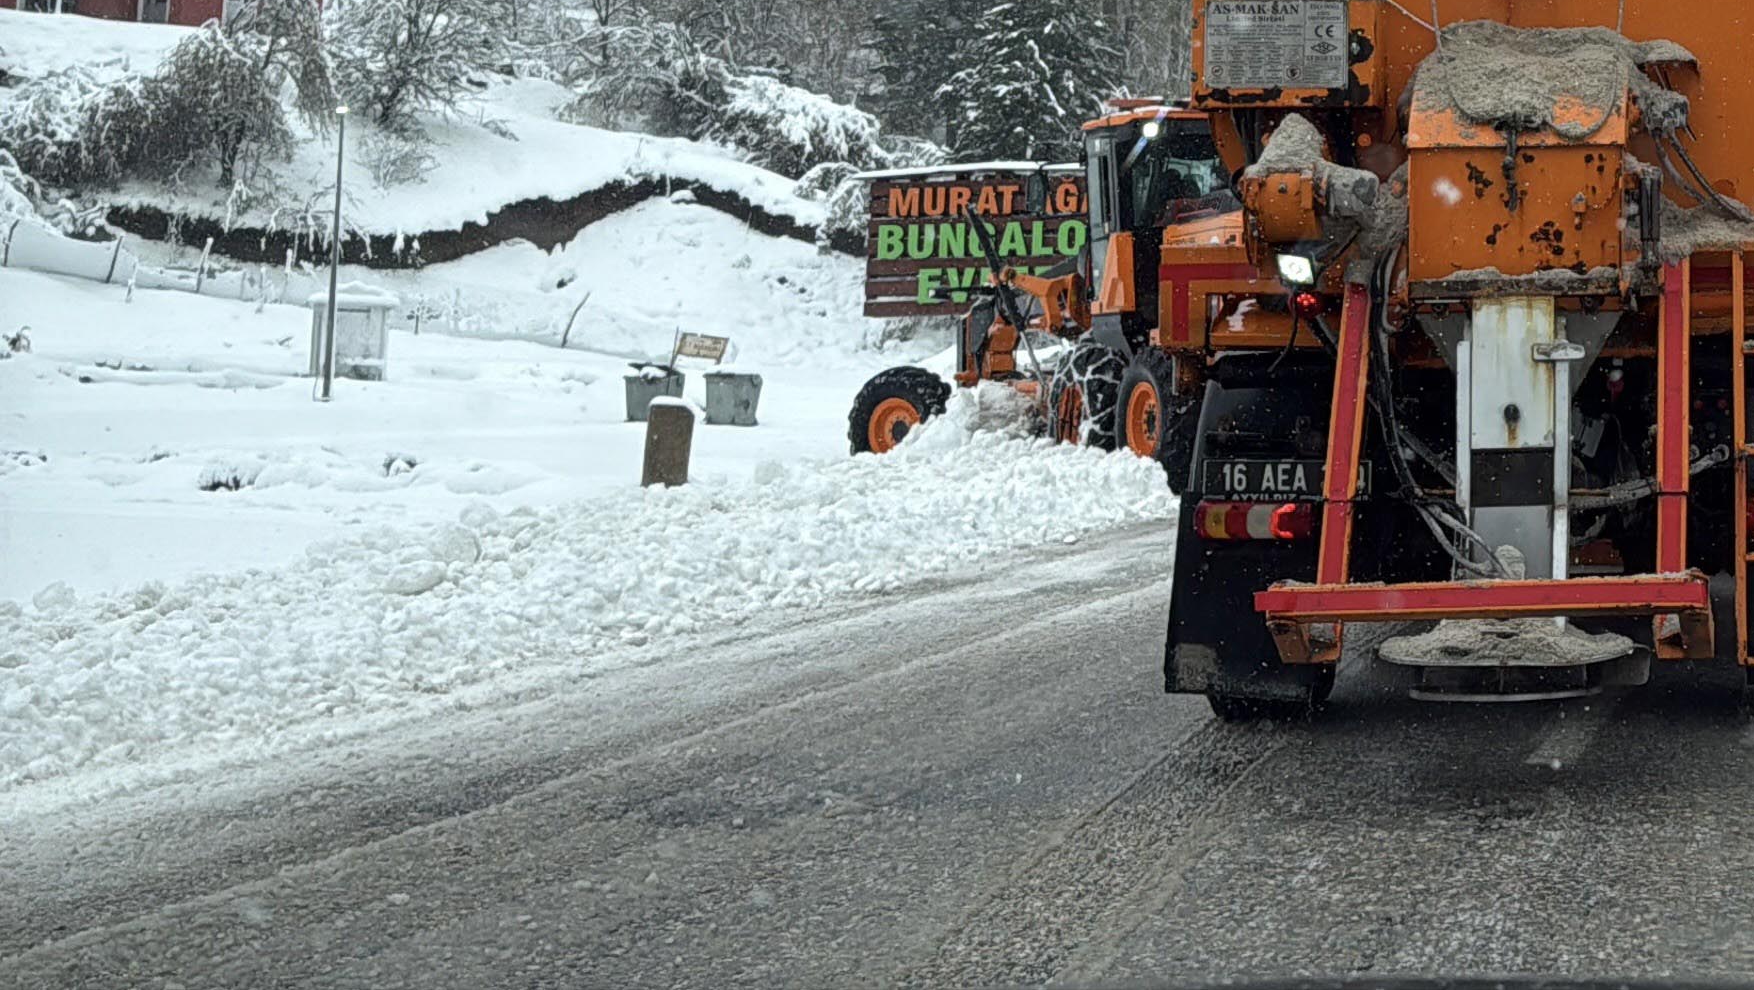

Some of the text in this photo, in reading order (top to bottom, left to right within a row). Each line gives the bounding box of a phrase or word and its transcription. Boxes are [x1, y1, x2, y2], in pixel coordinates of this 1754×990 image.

[888, 185, 1019, 218] MURAT
[1223, 463, 1247, 492] 16
[1261, 463, 1307, 492] AEA
